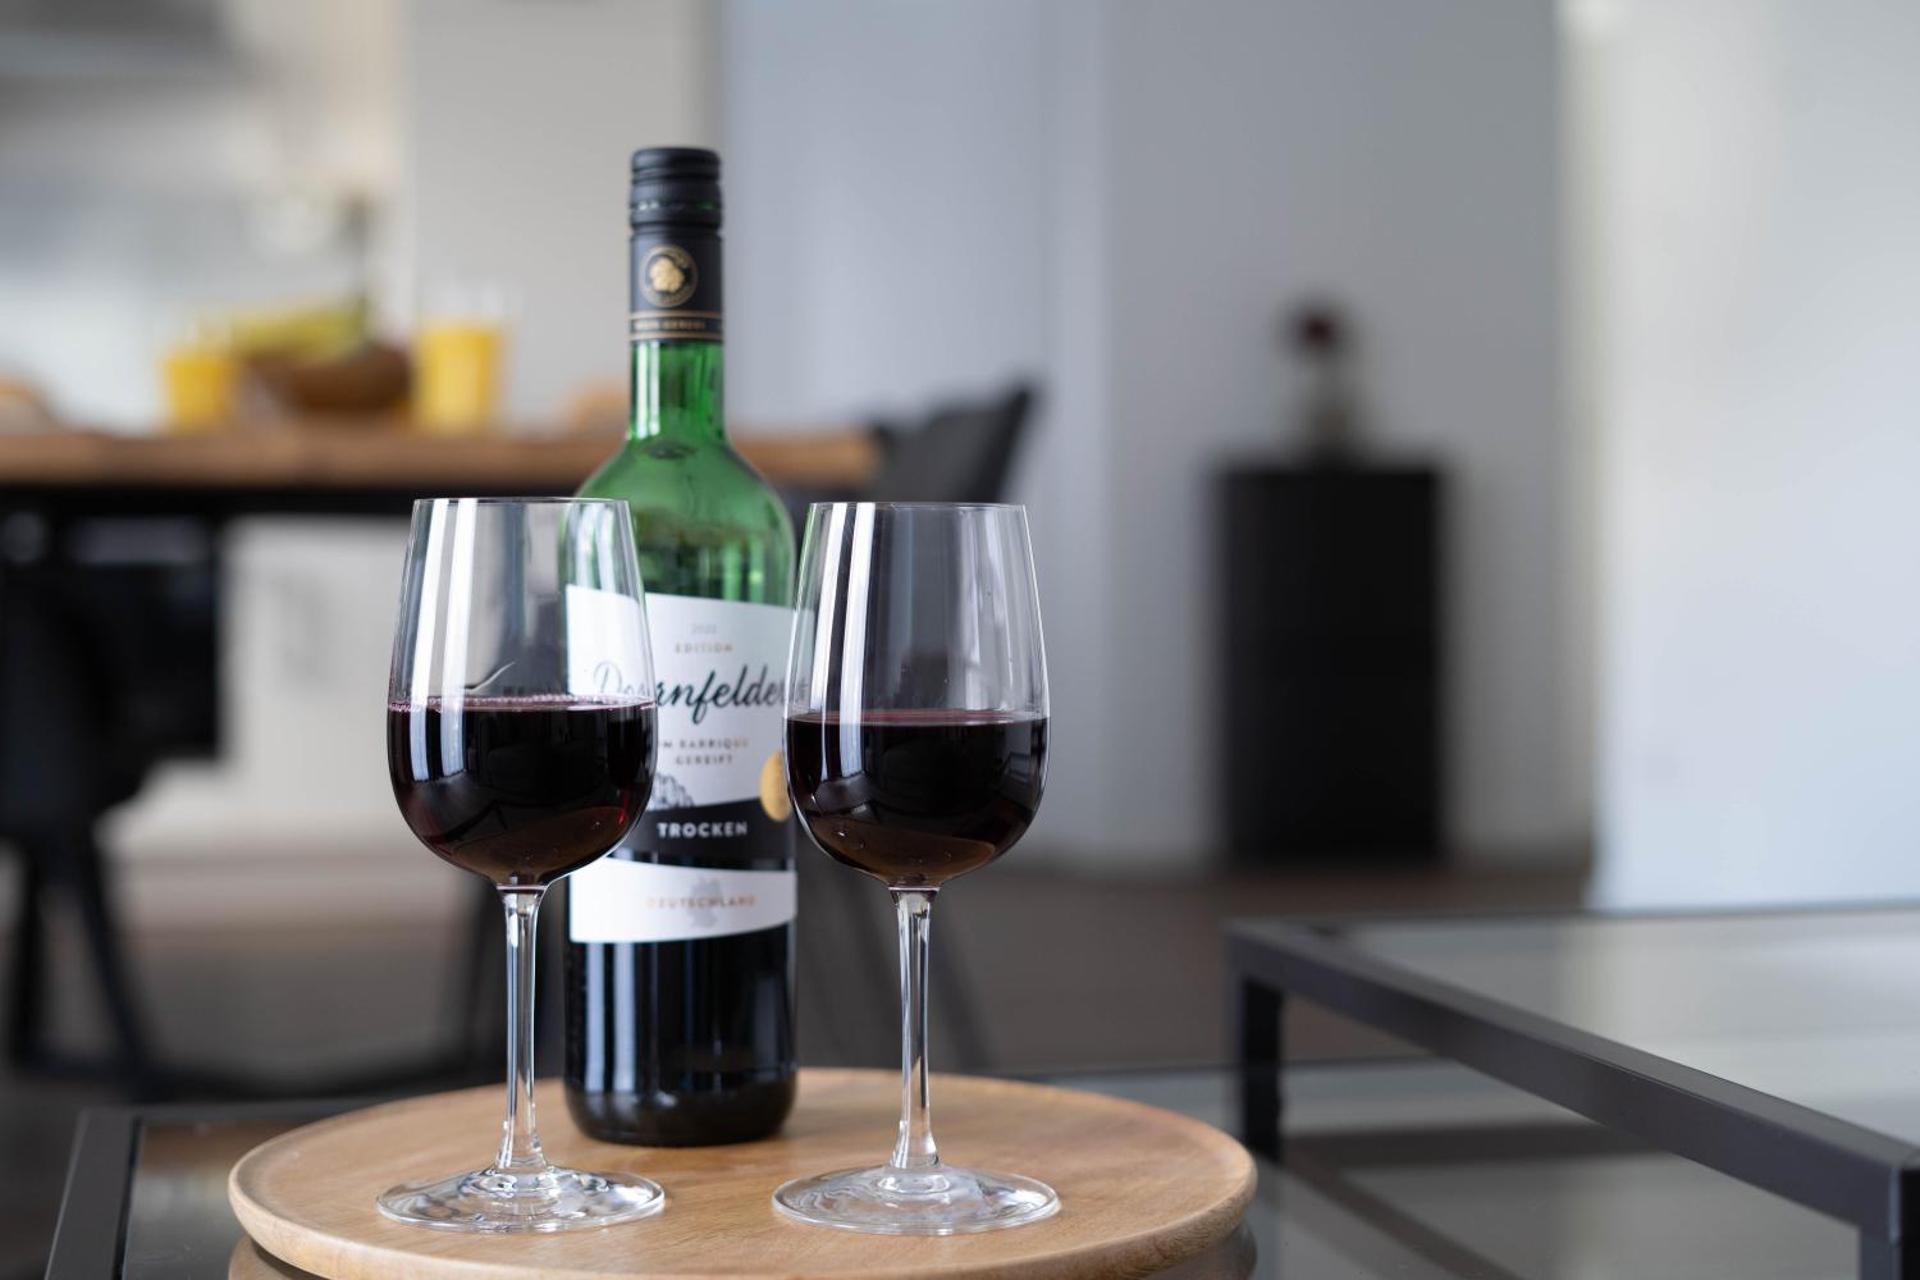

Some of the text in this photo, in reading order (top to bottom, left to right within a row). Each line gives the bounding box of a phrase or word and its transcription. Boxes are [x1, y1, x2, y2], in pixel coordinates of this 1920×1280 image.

[675, 642, 733, 653] EDITION
[657, 821, 748, 838] TROCKEN
[646, 895, 757, 908] DEUTSCHLAND
